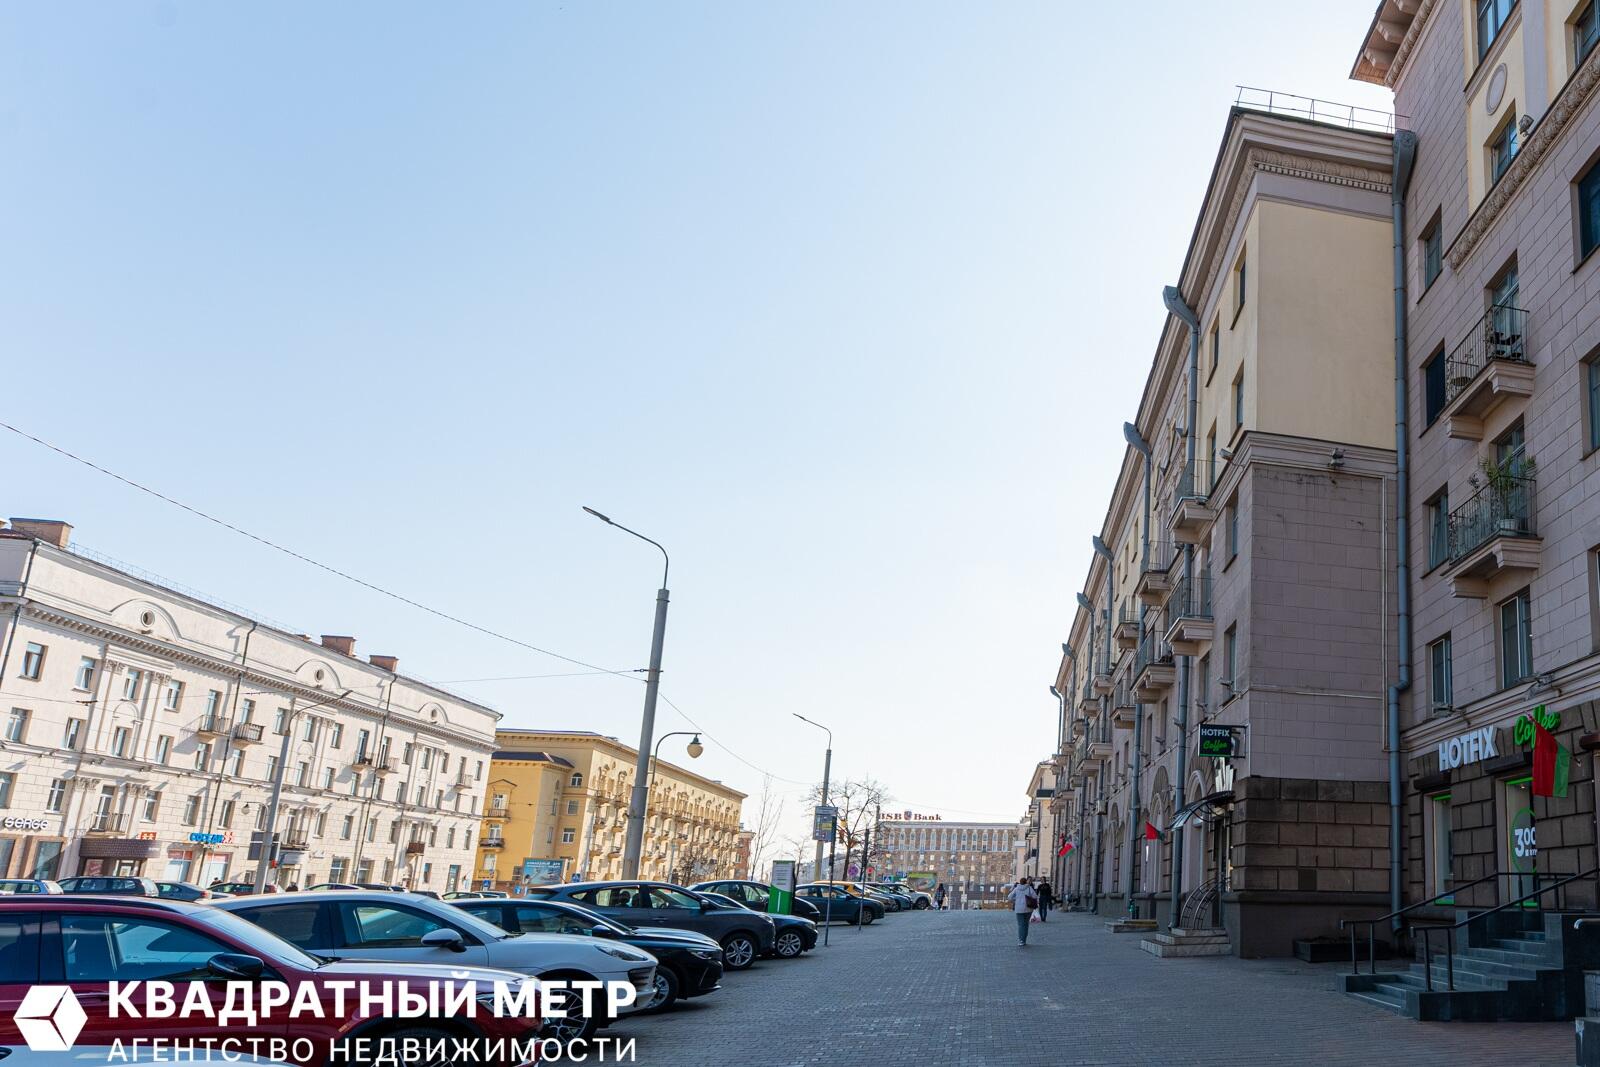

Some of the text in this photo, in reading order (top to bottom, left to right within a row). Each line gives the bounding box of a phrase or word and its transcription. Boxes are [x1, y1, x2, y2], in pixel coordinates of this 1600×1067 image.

[1201, 728, 1230, 737] HOTFIX
[1203, 740, 1228, 752] Coffee
[1438, 724, 1497, 772] HOTFIX
[914, 813, 943, 821] Bank
